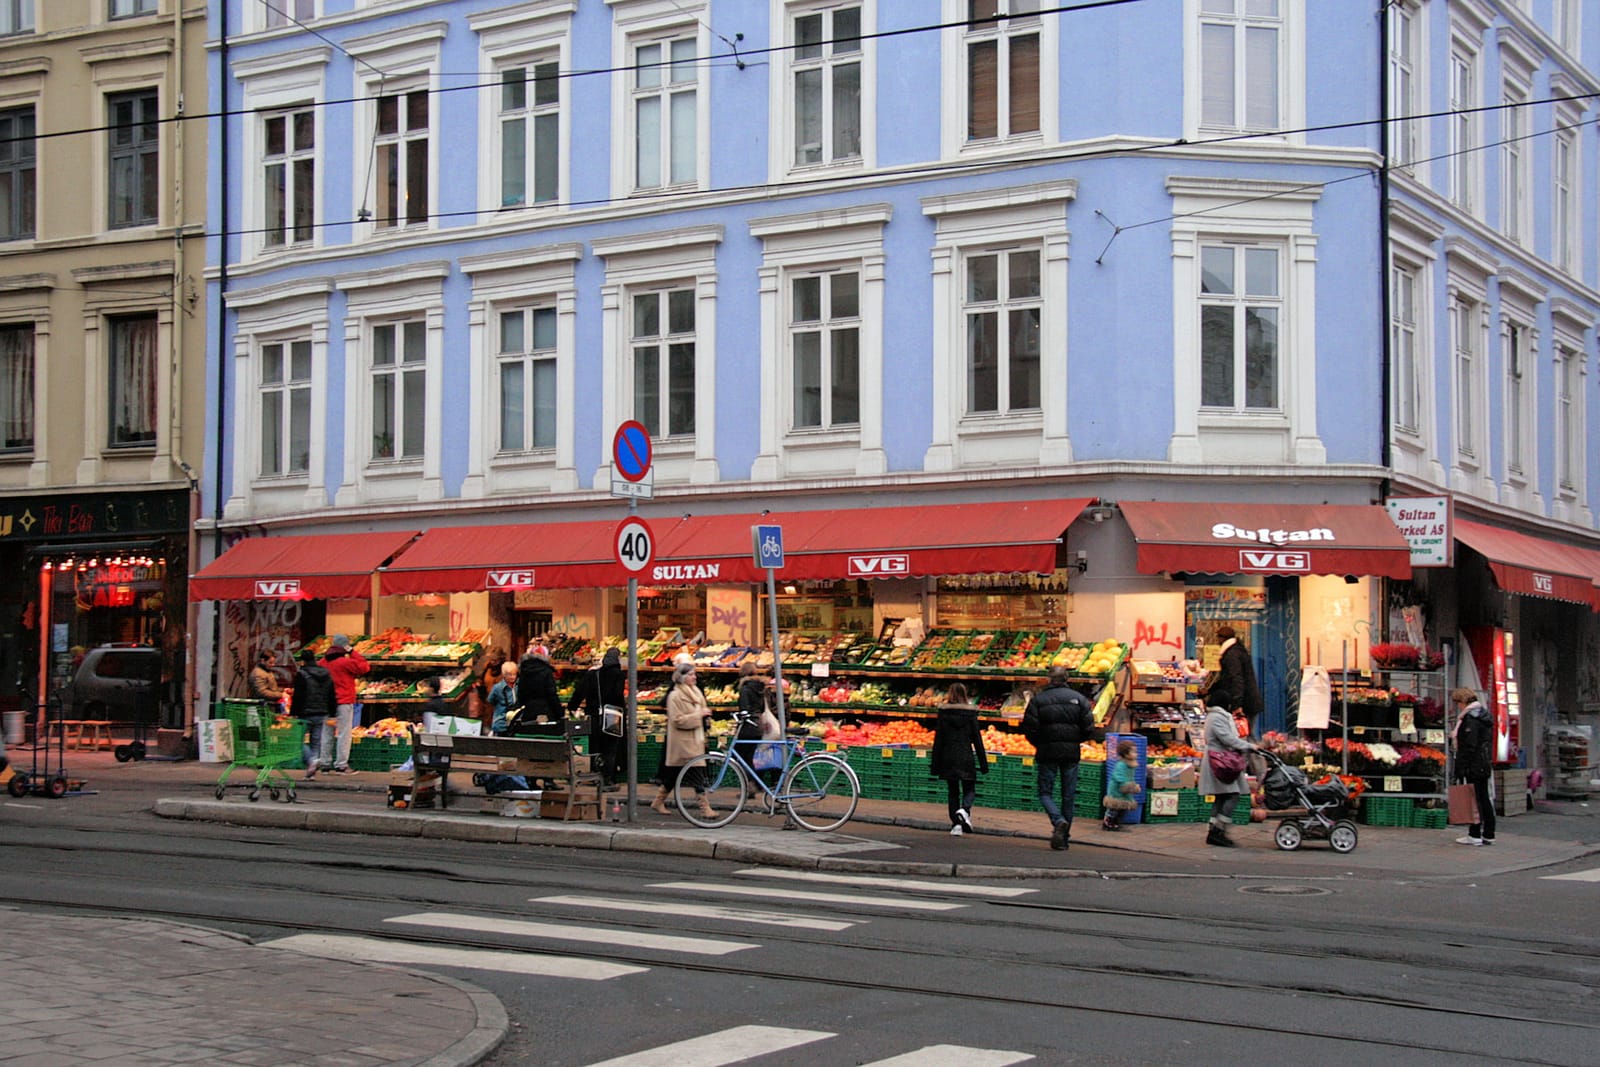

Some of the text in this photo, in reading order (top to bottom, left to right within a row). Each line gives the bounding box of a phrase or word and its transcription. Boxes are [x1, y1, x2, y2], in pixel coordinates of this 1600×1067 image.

[43, 504, 95, 534] Tiki Bar
[1398, 509, 1436, 520] Sultan
[1211, 523, 1336, 543] Sultan
[1430, 524, 1445, 536] AS
[621, 533, 648, 562] 40
[852, 557, 905, 572] VG
[1244, 553, 1305, 568] VG
[490, 572, 532, 586] VG
[653, 563, 720, 580] SULTAN
[258, 582, 298, 595] VG
[1535, 576, 1553, 591] VG
